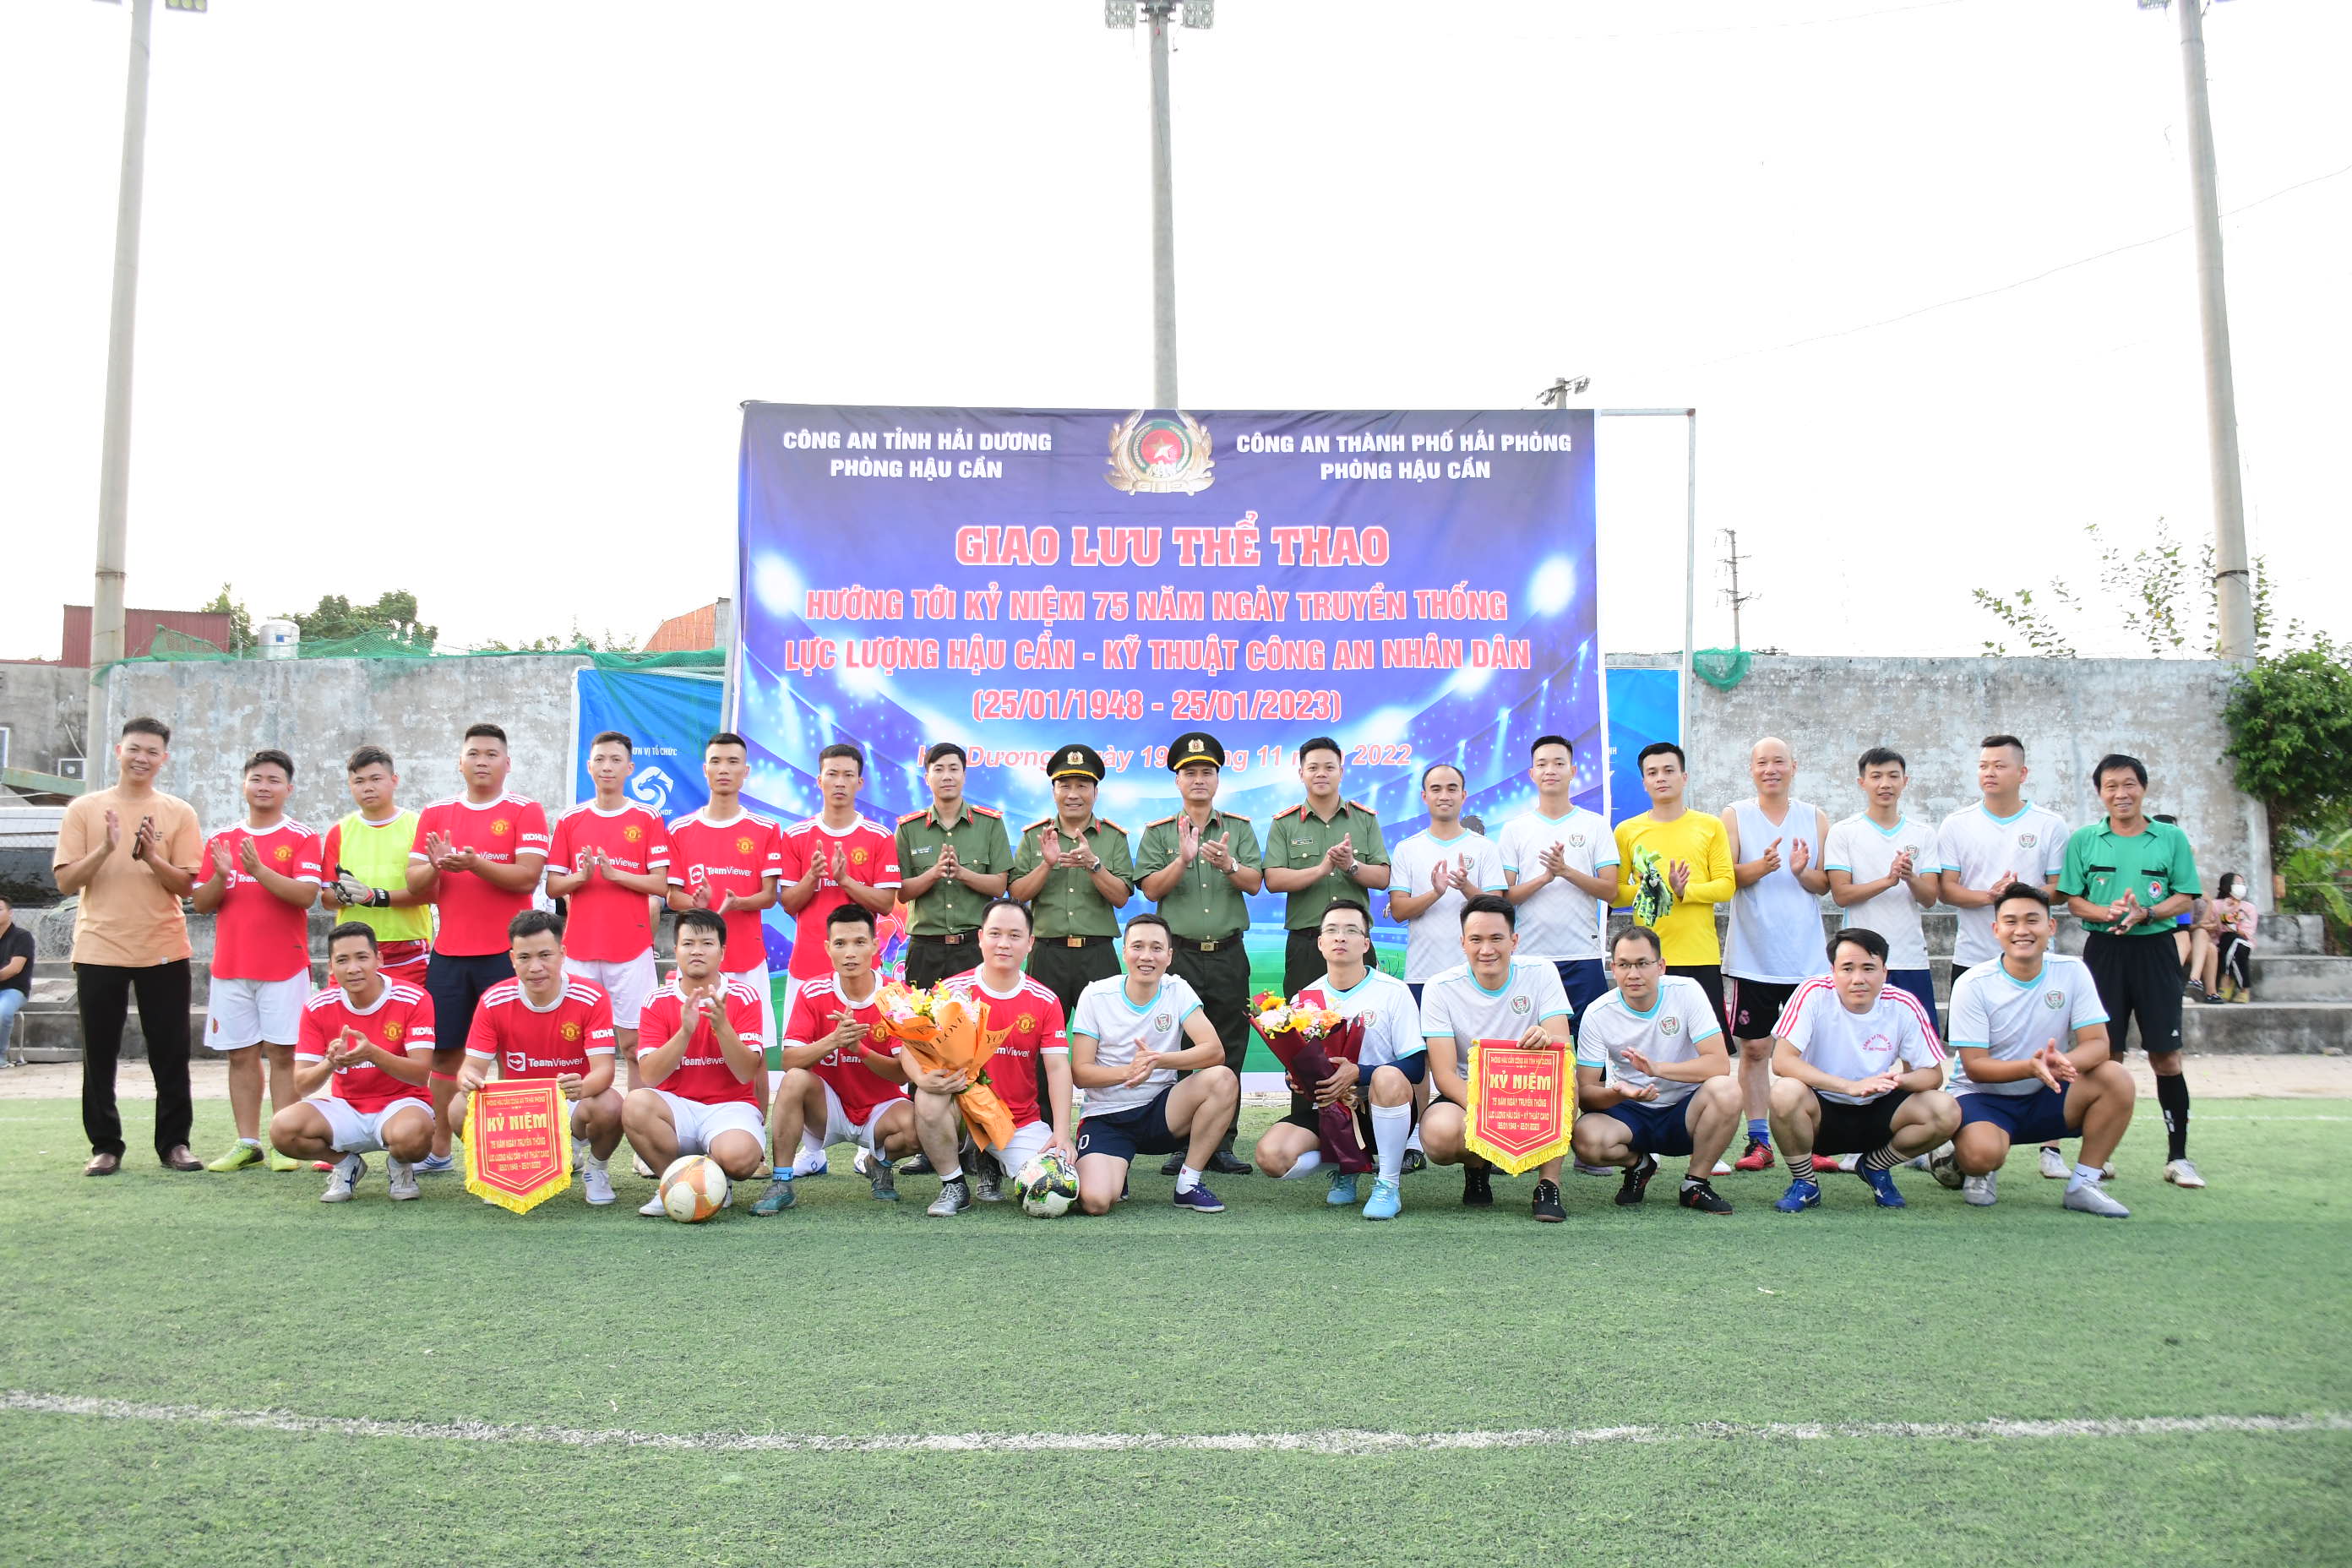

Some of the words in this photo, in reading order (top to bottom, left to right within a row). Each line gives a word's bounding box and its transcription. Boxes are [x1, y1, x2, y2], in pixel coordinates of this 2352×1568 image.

[783, 427, 841, 450] CÔNG
[847, 432, 877, 450] AN
[884, 427, 930, 450] TỈNH
[938, 427, 973, 451] HẢI
[979, 432, 1053, 452] DƯƠNG
[1237, 432, 1294, 454] CÔNG
[1300, 434, 1330, 454] AN
[1336, 433, 1405, 454] THÀNH
[1412, 428, 1454, 454] PHỐ
[1460, 429, 1494, 453] HẢI
[1500, 431, 1572, 453] PHÒNG
[830, 456, 903, 478] PHÒNG
[914, 457, 952, 482] HẬU
[958, 455, 1003, 479] CẦN
[1320, 458, 1392, 480] PHÒNG
[1398, 458, 1440, 483] HẬU
[1447, 455, 1491, 479] CẦN
[956, 525, 1060, 566] GIAO
[1071, 525, 1162, 567] LƯU
[1172, 510, 1261, 567] THỂ
[1271, 525, 1391, 567] THAO
[805, 584, 904, 620] HƯỚNG
[912, 585, 956, 620] TỚI
[964, 581, 1002, 621] KỶ
[1010, 585, 1085, 627] NIỆM
[1092, 591, 1129, 621] 75
[1137, 586, 1205, 621] NĂM
[1212, 585, 1290, 622] NGÀY
[1296, 582, 1407, 621] TRUYỀN
[1413, 581, 1509, 621] THỐNG
[785, 635, 836, 676] LỰC
[845, 635, 939, 676] LƯỢNG
[947, 634, 1006, 675] HẬU
[1015, 630, 1075, 670] CẦN
[1082, 651, 1096, 661] -
[1103, 634, 1141, 670] KỸ
[1149, 634, 1239, 676] THUẬT
[1245, 635, 1326, 671] CÔNG
[1332, 639, 1375, 670] AN
[1382, 634, 1464, 670] NHÂN
[1471, 634, 1531, 670] DÂN
[972, 689, 1145, 721] (25/01/1948
[1151, 701, 1164, 711] -
[1172, 689, 1342, 722] 25/01/2023)
[1097, 744, 1134, 772] ày
[1141, 745, 1171, 767] 19
[1257, 745, 1282, 766] 11
[1352, 743, 1413, 765] 2022
[528, 1058, 584, 1068] TeamViewer
[1489, 1070, 1508, 1089] KỶ
[1513, 1072, 1551, 1093] NIỆM
[509, 1112, 547, 1132] NIỆM
